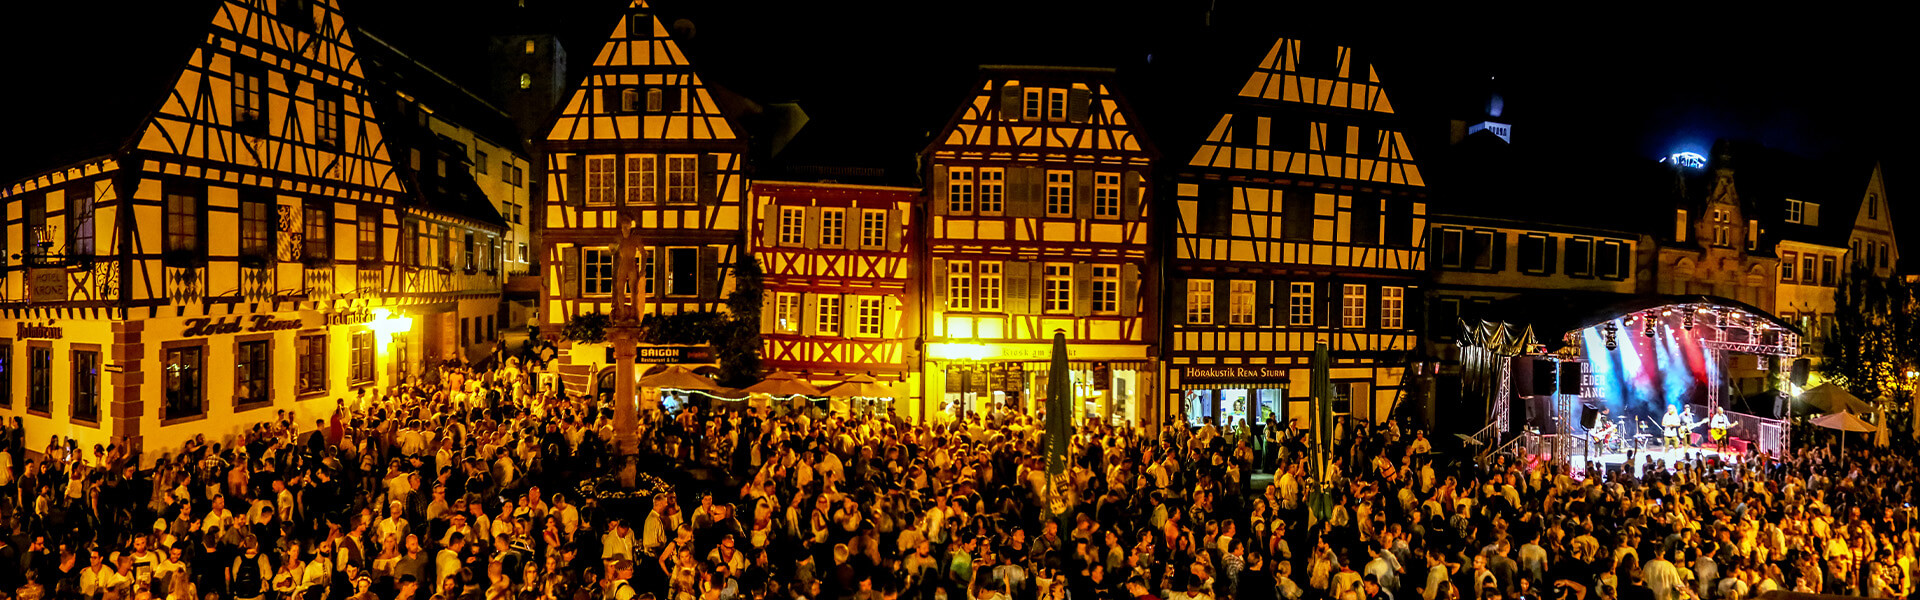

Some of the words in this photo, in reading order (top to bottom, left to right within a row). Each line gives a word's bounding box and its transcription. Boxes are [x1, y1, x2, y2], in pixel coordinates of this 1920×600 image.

[36, 273, 61, 282] HOTEL
[33, 285, 64, 295] KRONE
[183, 316, 242, 337] Hotel
[248, 315, 303, 332] Krone
